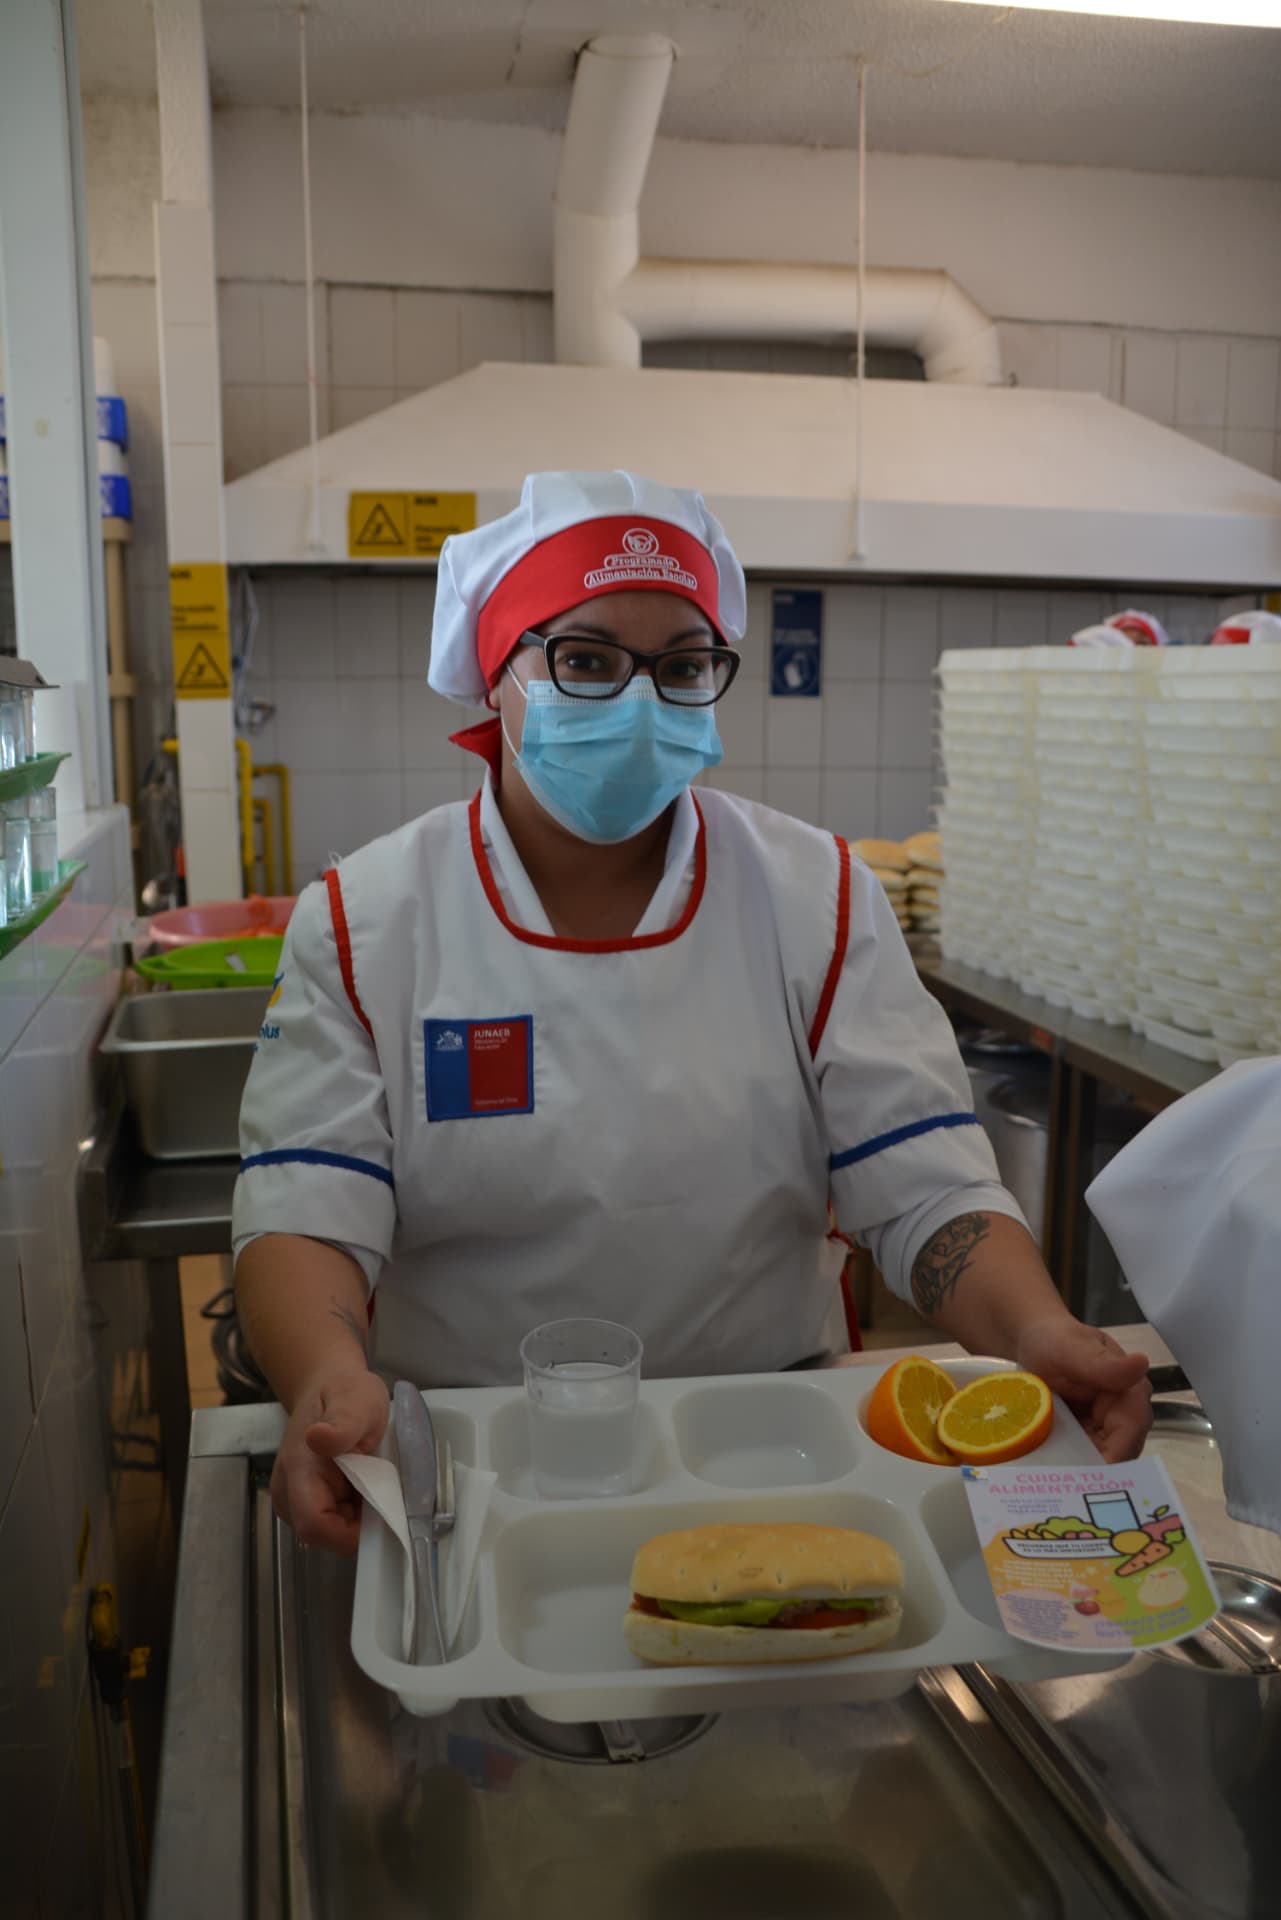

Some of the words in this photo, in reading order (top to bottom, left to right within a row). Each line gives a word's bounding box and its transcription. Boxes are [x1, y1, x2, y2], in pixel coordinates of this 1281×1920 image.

[588, 567, 661, 586] Alimentación
[662, 569, 697, 588] Escolar
[473, 1027, 511, 1039] JUNAEB
[1015, 1472, 1076, 1484] CUIDA
[1079, 1471, 1105, 1483] TU
[988, 1477, 1136, 1495] ALIMENTACIÓN
